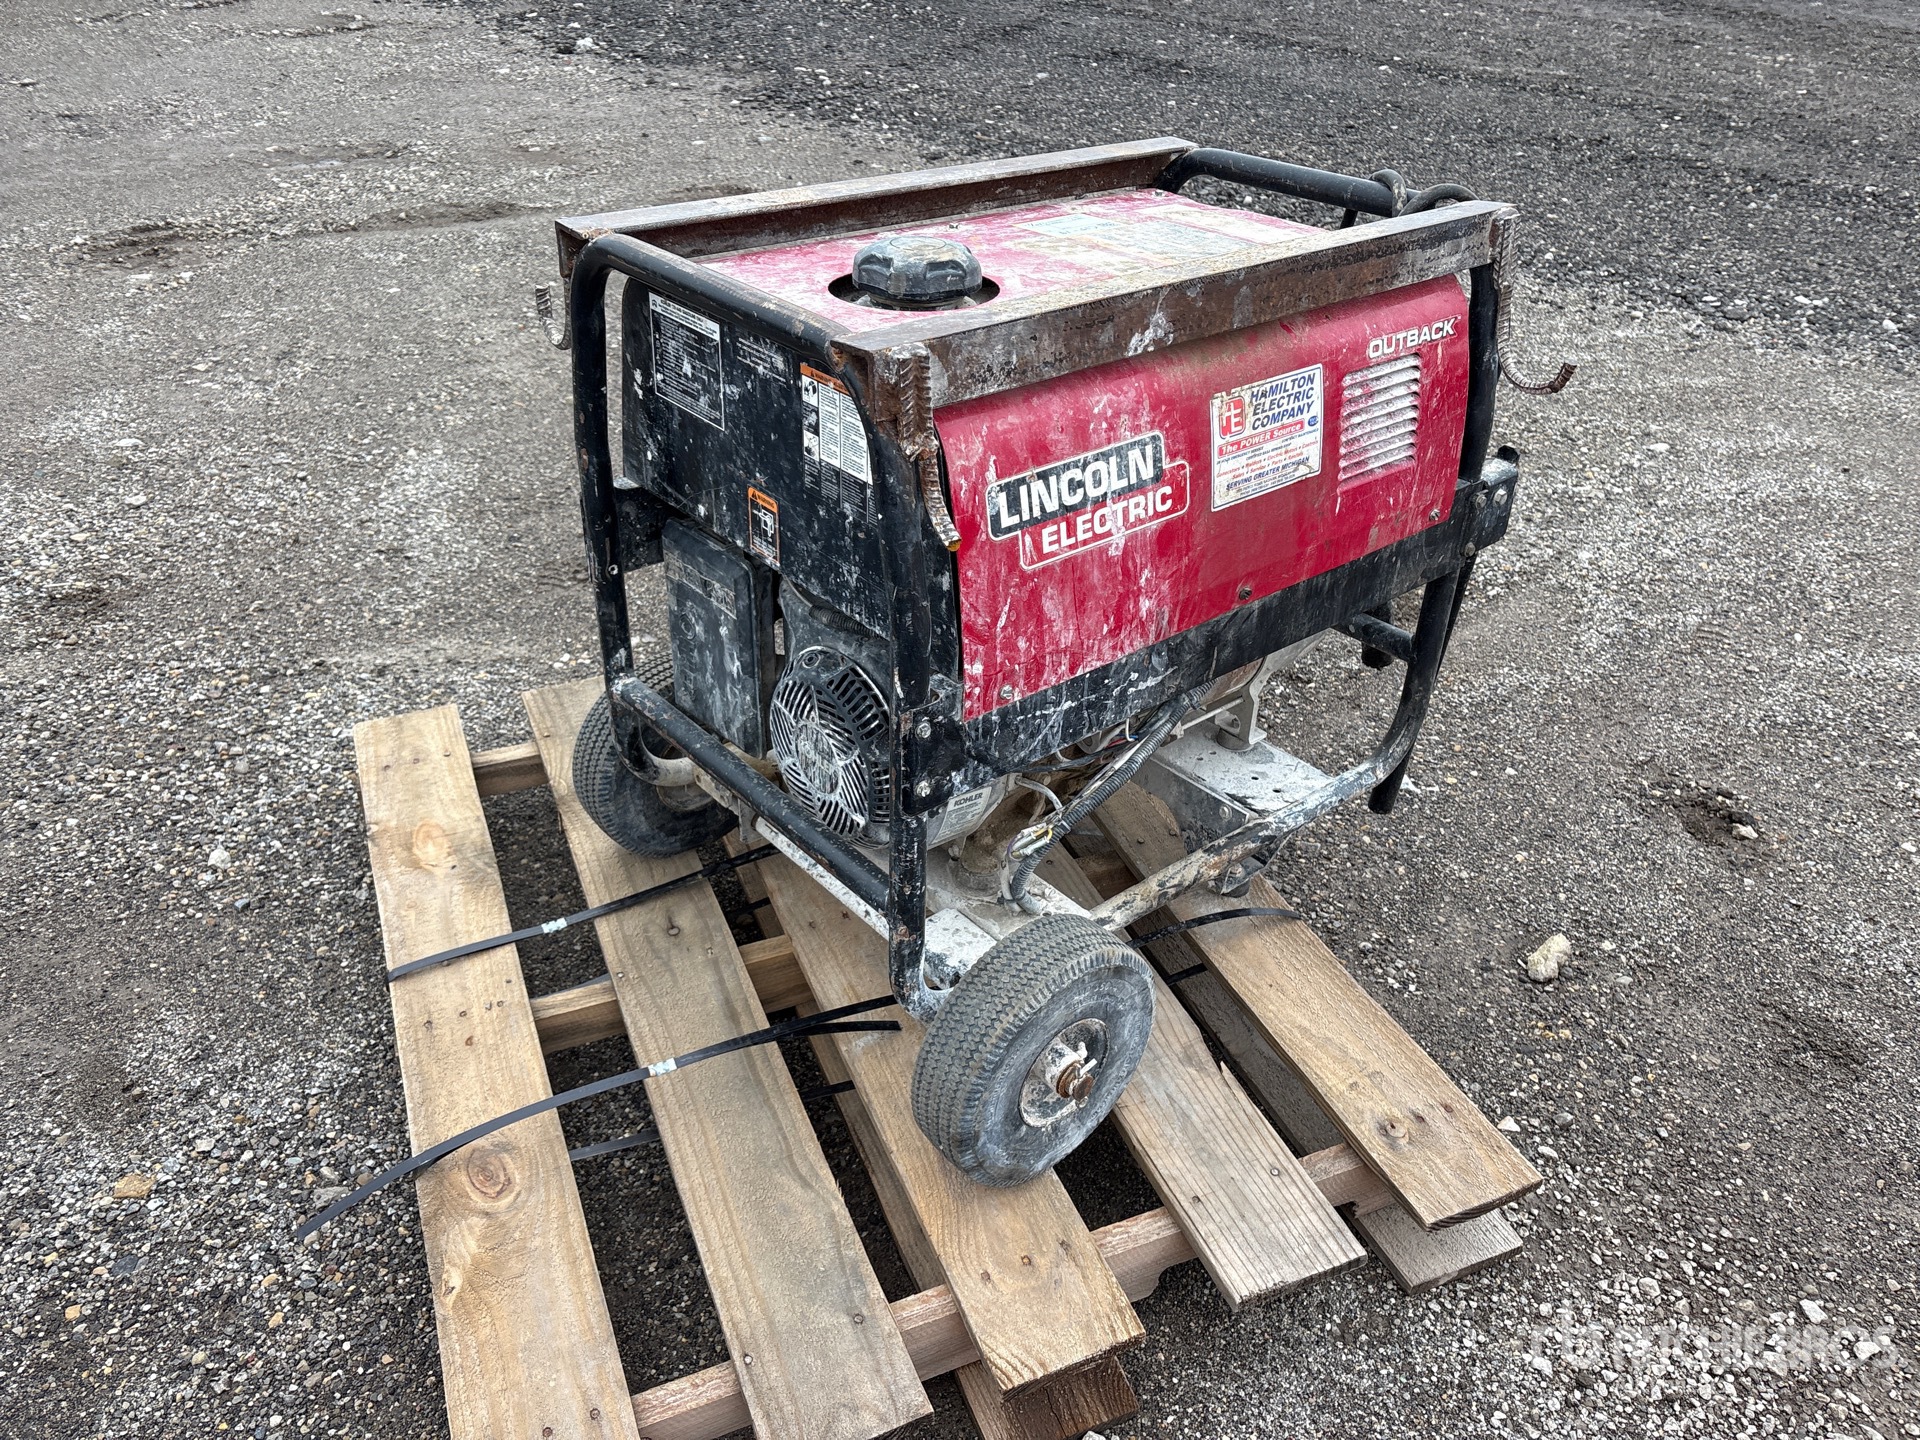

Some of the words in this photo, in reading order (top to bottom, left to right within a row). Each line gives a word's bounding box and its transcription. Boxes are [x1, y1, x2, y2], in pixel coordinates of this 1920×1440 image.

[1369, 317, 1456, 359] OUTBACK
[1250, 373, 1315, 404] HAMILTON
[1251, 387, 1314, 417] ELECTRIC
[1251, 400, 1314, 431] COMPANY
[1221, 441, 1238, 455] The
[1239, 432, 1271, 449] POWER
[1272, 423, 1301, 438] Source
[1225, 475, 1252, 490] SERVING
[1253, 465, 1280, 481] GREATER
[1281, 455, 1309, 471] MICHIGAN
[1271, 457, 1283, 466] Parts
[997, 443, 1155, 529] LINCOLN
[1041, 485, 1173, 554] ELECTRIC
[953, 792, 983, 807] KOHLER
